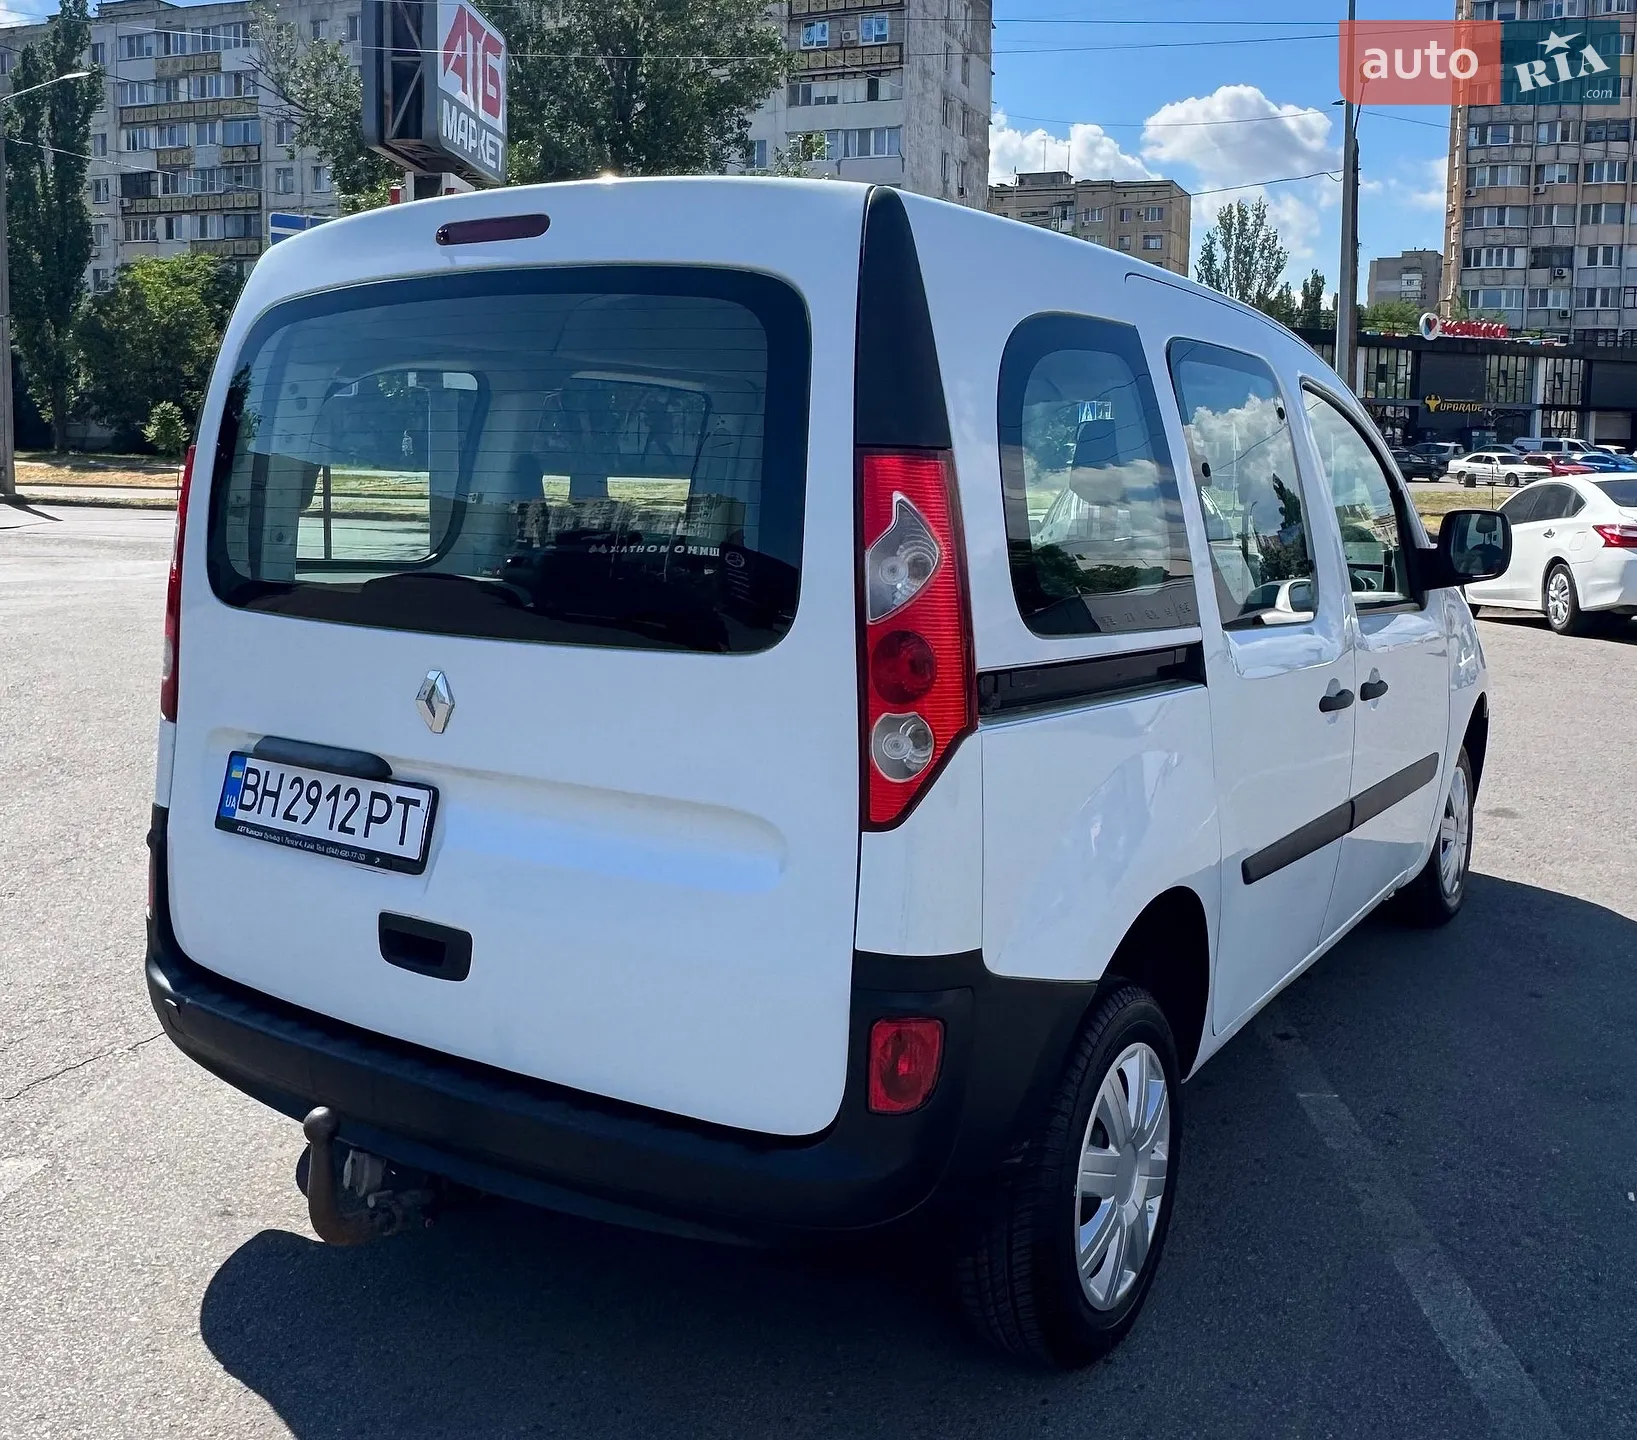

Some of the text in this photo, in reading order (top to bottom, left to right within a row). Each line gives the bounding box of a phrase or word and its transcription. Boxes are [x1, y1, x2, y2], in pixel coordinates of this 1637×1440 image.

[443, 4, 504, 120] АТБ
[443, 99, 504, 172] МАРКЕТ
[225, 794, 237, 810] UA
